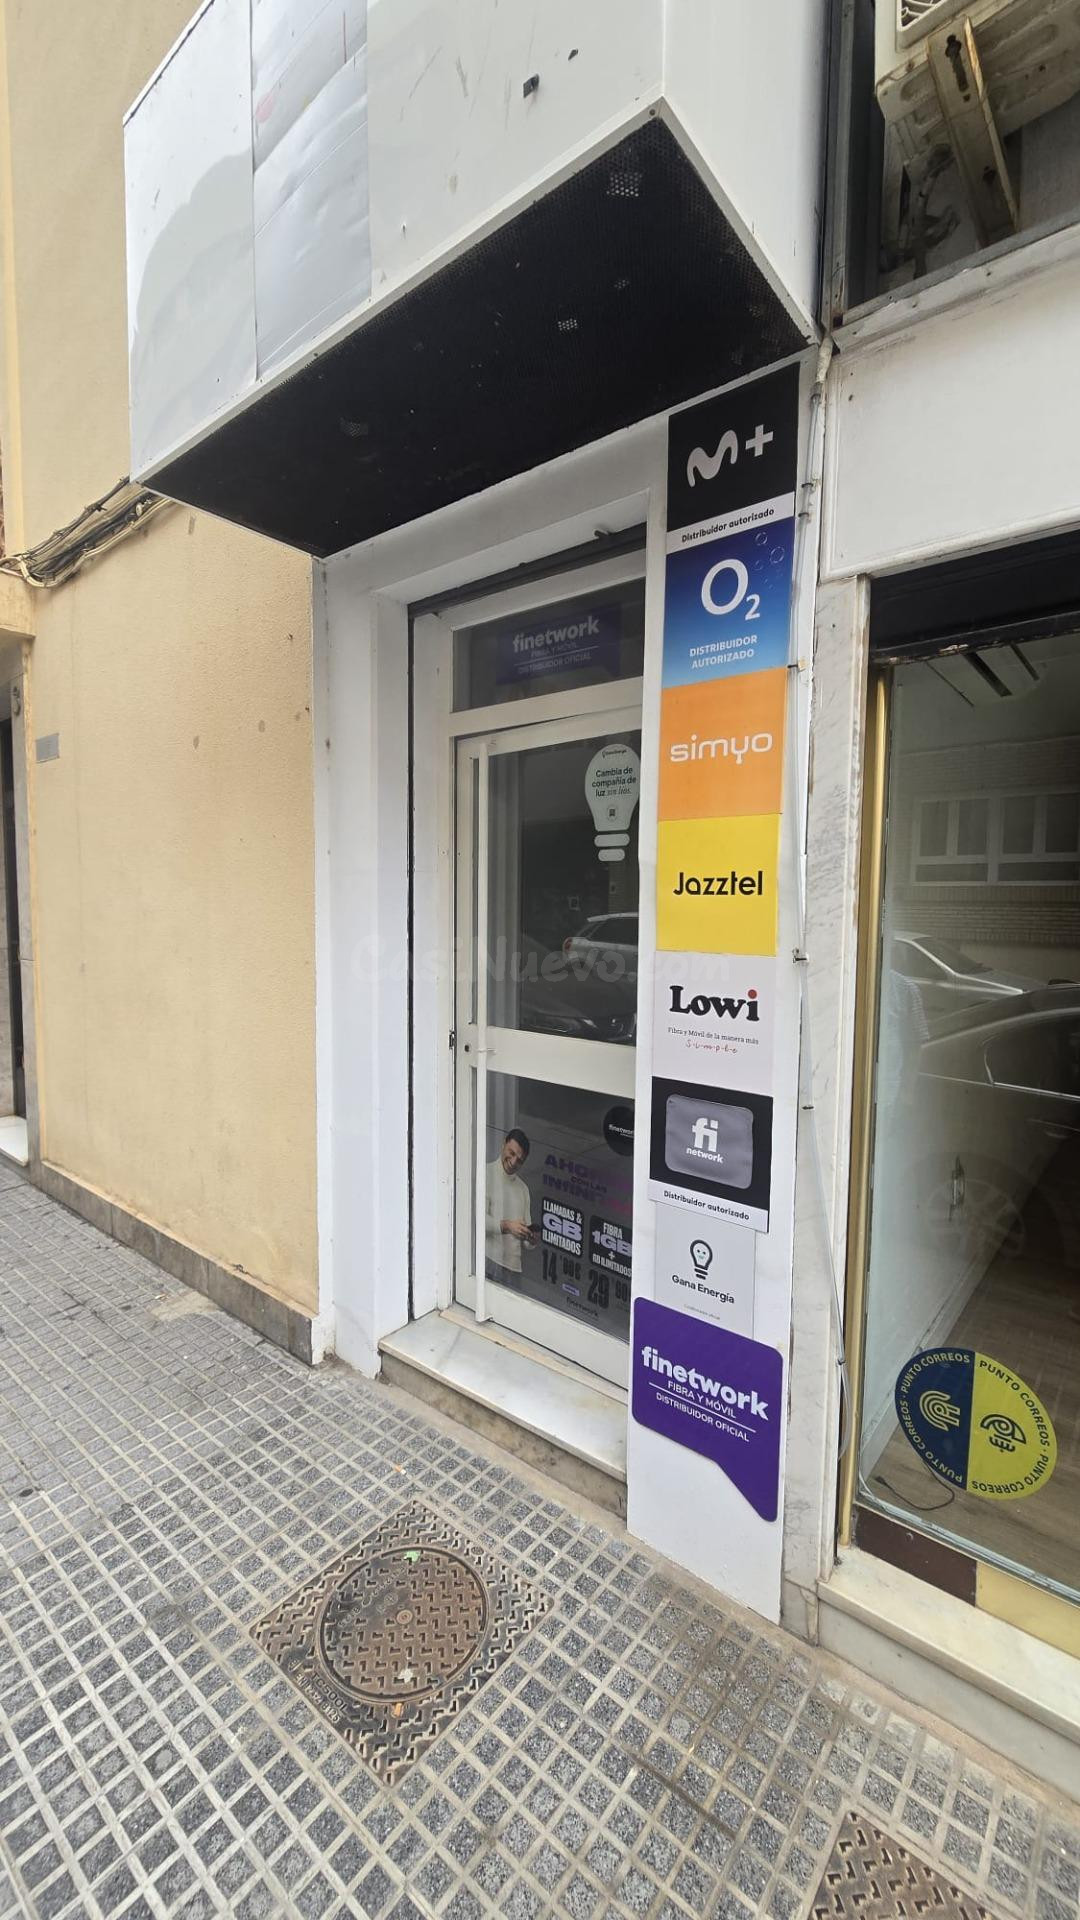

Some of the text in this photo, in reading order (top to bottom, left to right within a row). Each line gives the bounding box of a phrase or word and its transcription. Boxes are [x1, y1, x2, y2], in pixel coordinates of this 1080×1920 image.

[681, 508, 775, 543] Distribuidor autorizado
[512, 615, 600, 653] finetwork
[689, 634, 758, 657] DISTRIBUIDOR
[691, 649, 755, 669] AUTORIZADO
[670, 733, 773, 765] simyo
[592, 776, 637, 788] compañía de
[595, 766, 633, 777] Cambia de
[595, 789, 605, 797] luz
[673, 871, 763, 896] Jazztel
[669, 985, 760, 1022] Lowi
[668, 1026, 682, 1035] Fibra
[688, 1029, 705, 1038] Móvil
[746, 1037, 759, 1045] más
[609, 1123, 634, 1135] finetwor
[692, 1117, 719, 1153] fi
[685, 1146, 724, 1164] network
[543, 1200, 583, 1224] LLAMADAS &
[663, 1190, 750, 1221] Distribuidor autorizado
[542, 1212, 583, 1242] GB
[603, 1222, 623, 1239] FIBRA
[542, 1229, 581, 1256] ILIMITADOS
[592, 1230, 633, 1258] 1GB
[671, 1274, 735, 1304] Gana Energía
[641, 1345, 769, 1421] finetwork
[901, 1352, 970, 1393] PUNTO CORREOS
[668, 1380, 736, 1419] FIBRA Y MÓVIL
[979, 1360, 1050, 1447] PUNTO CORREOS
[656, 1392, 750, 1442] DISTRIBUIDOR OFICIAL
[900, 1400, 963, 1483] PUNTO CORREOS
[971, 1454, 1050, 1494] PUNTO CORREOS
